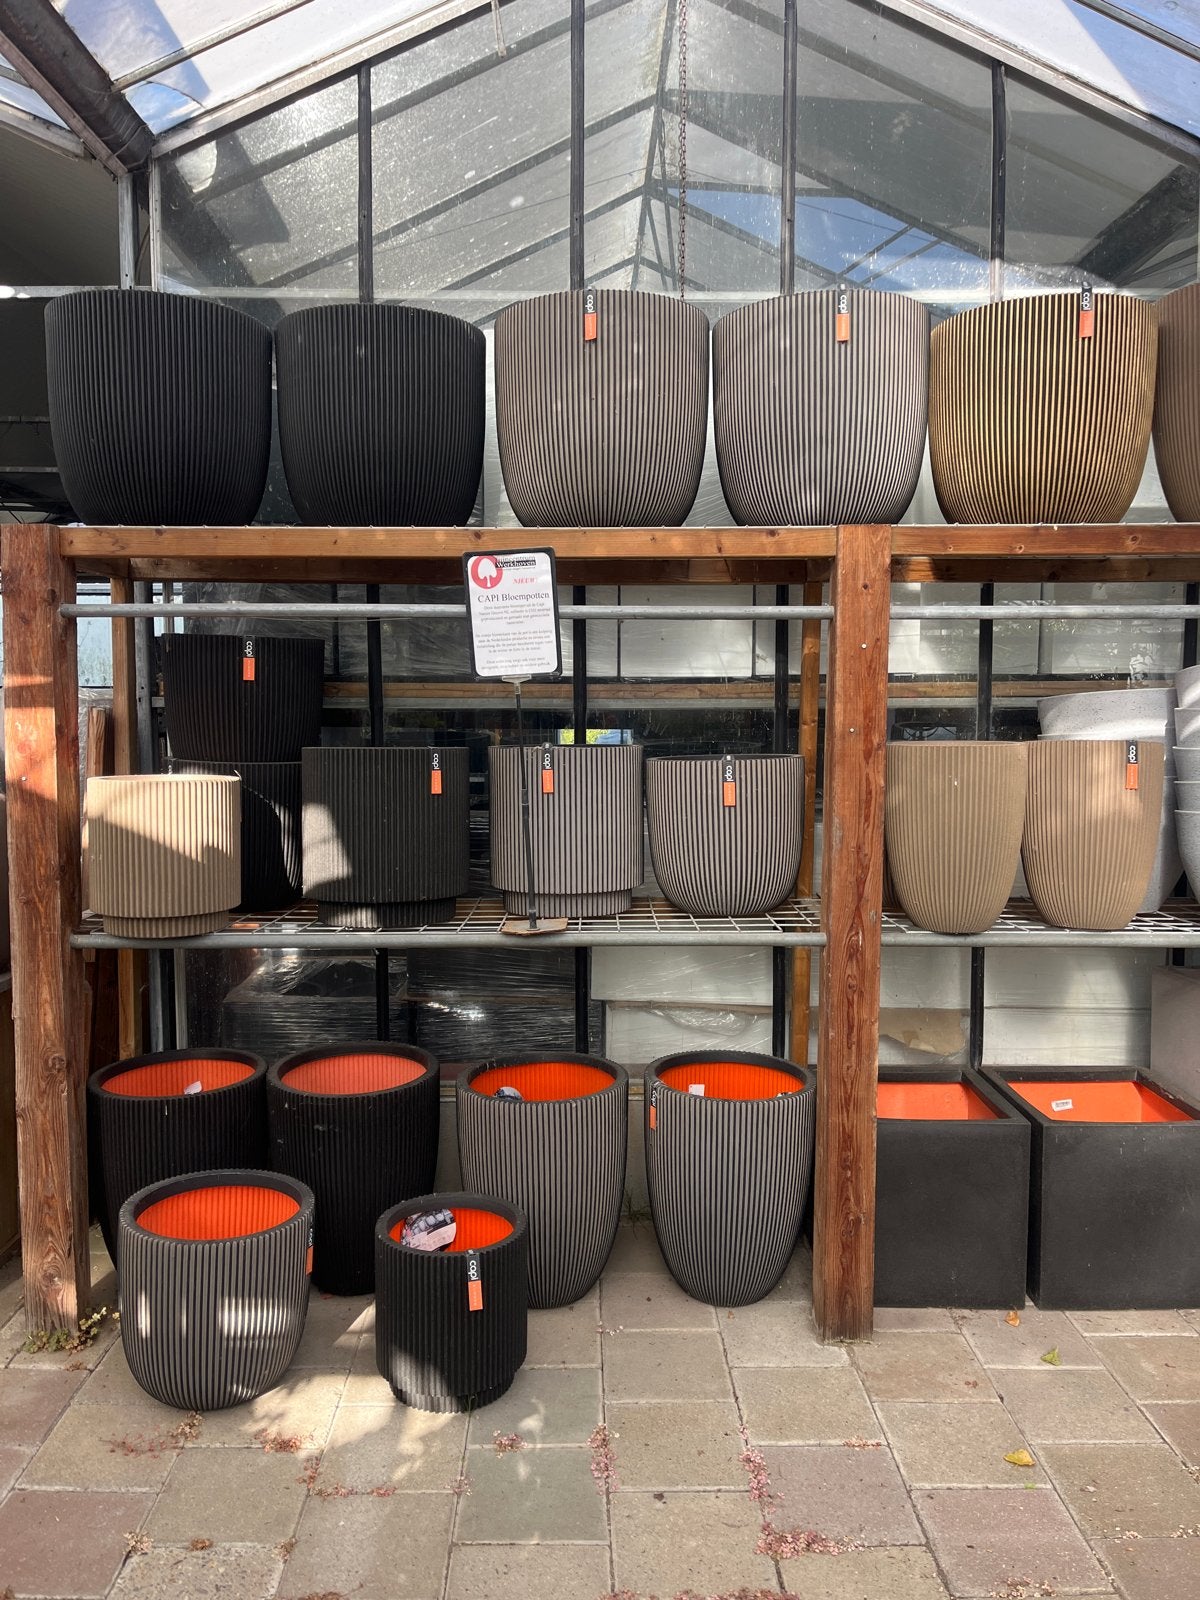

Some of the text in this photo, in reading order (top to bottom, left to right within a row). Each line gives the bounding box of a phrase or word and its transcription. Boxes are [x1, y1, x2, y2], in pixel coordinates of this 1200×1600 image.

[584, 294, 594, 313] capi
[838, 294, 848, 313] capi
[1081, 292, 1091, 310] capi
[496, 559, 536, 568] Werkhoven
[478, 592, 550, 603] CAPI Bloempotten
[244, 641, 253, 657] capi
[432, 753, 440, 770] capi
[543, 753, 552, 769] capi
[1128, 745, 1137, 763] capi
[724, 765, 734, 781] capi
[468, 1260, 479, 1280] capi
